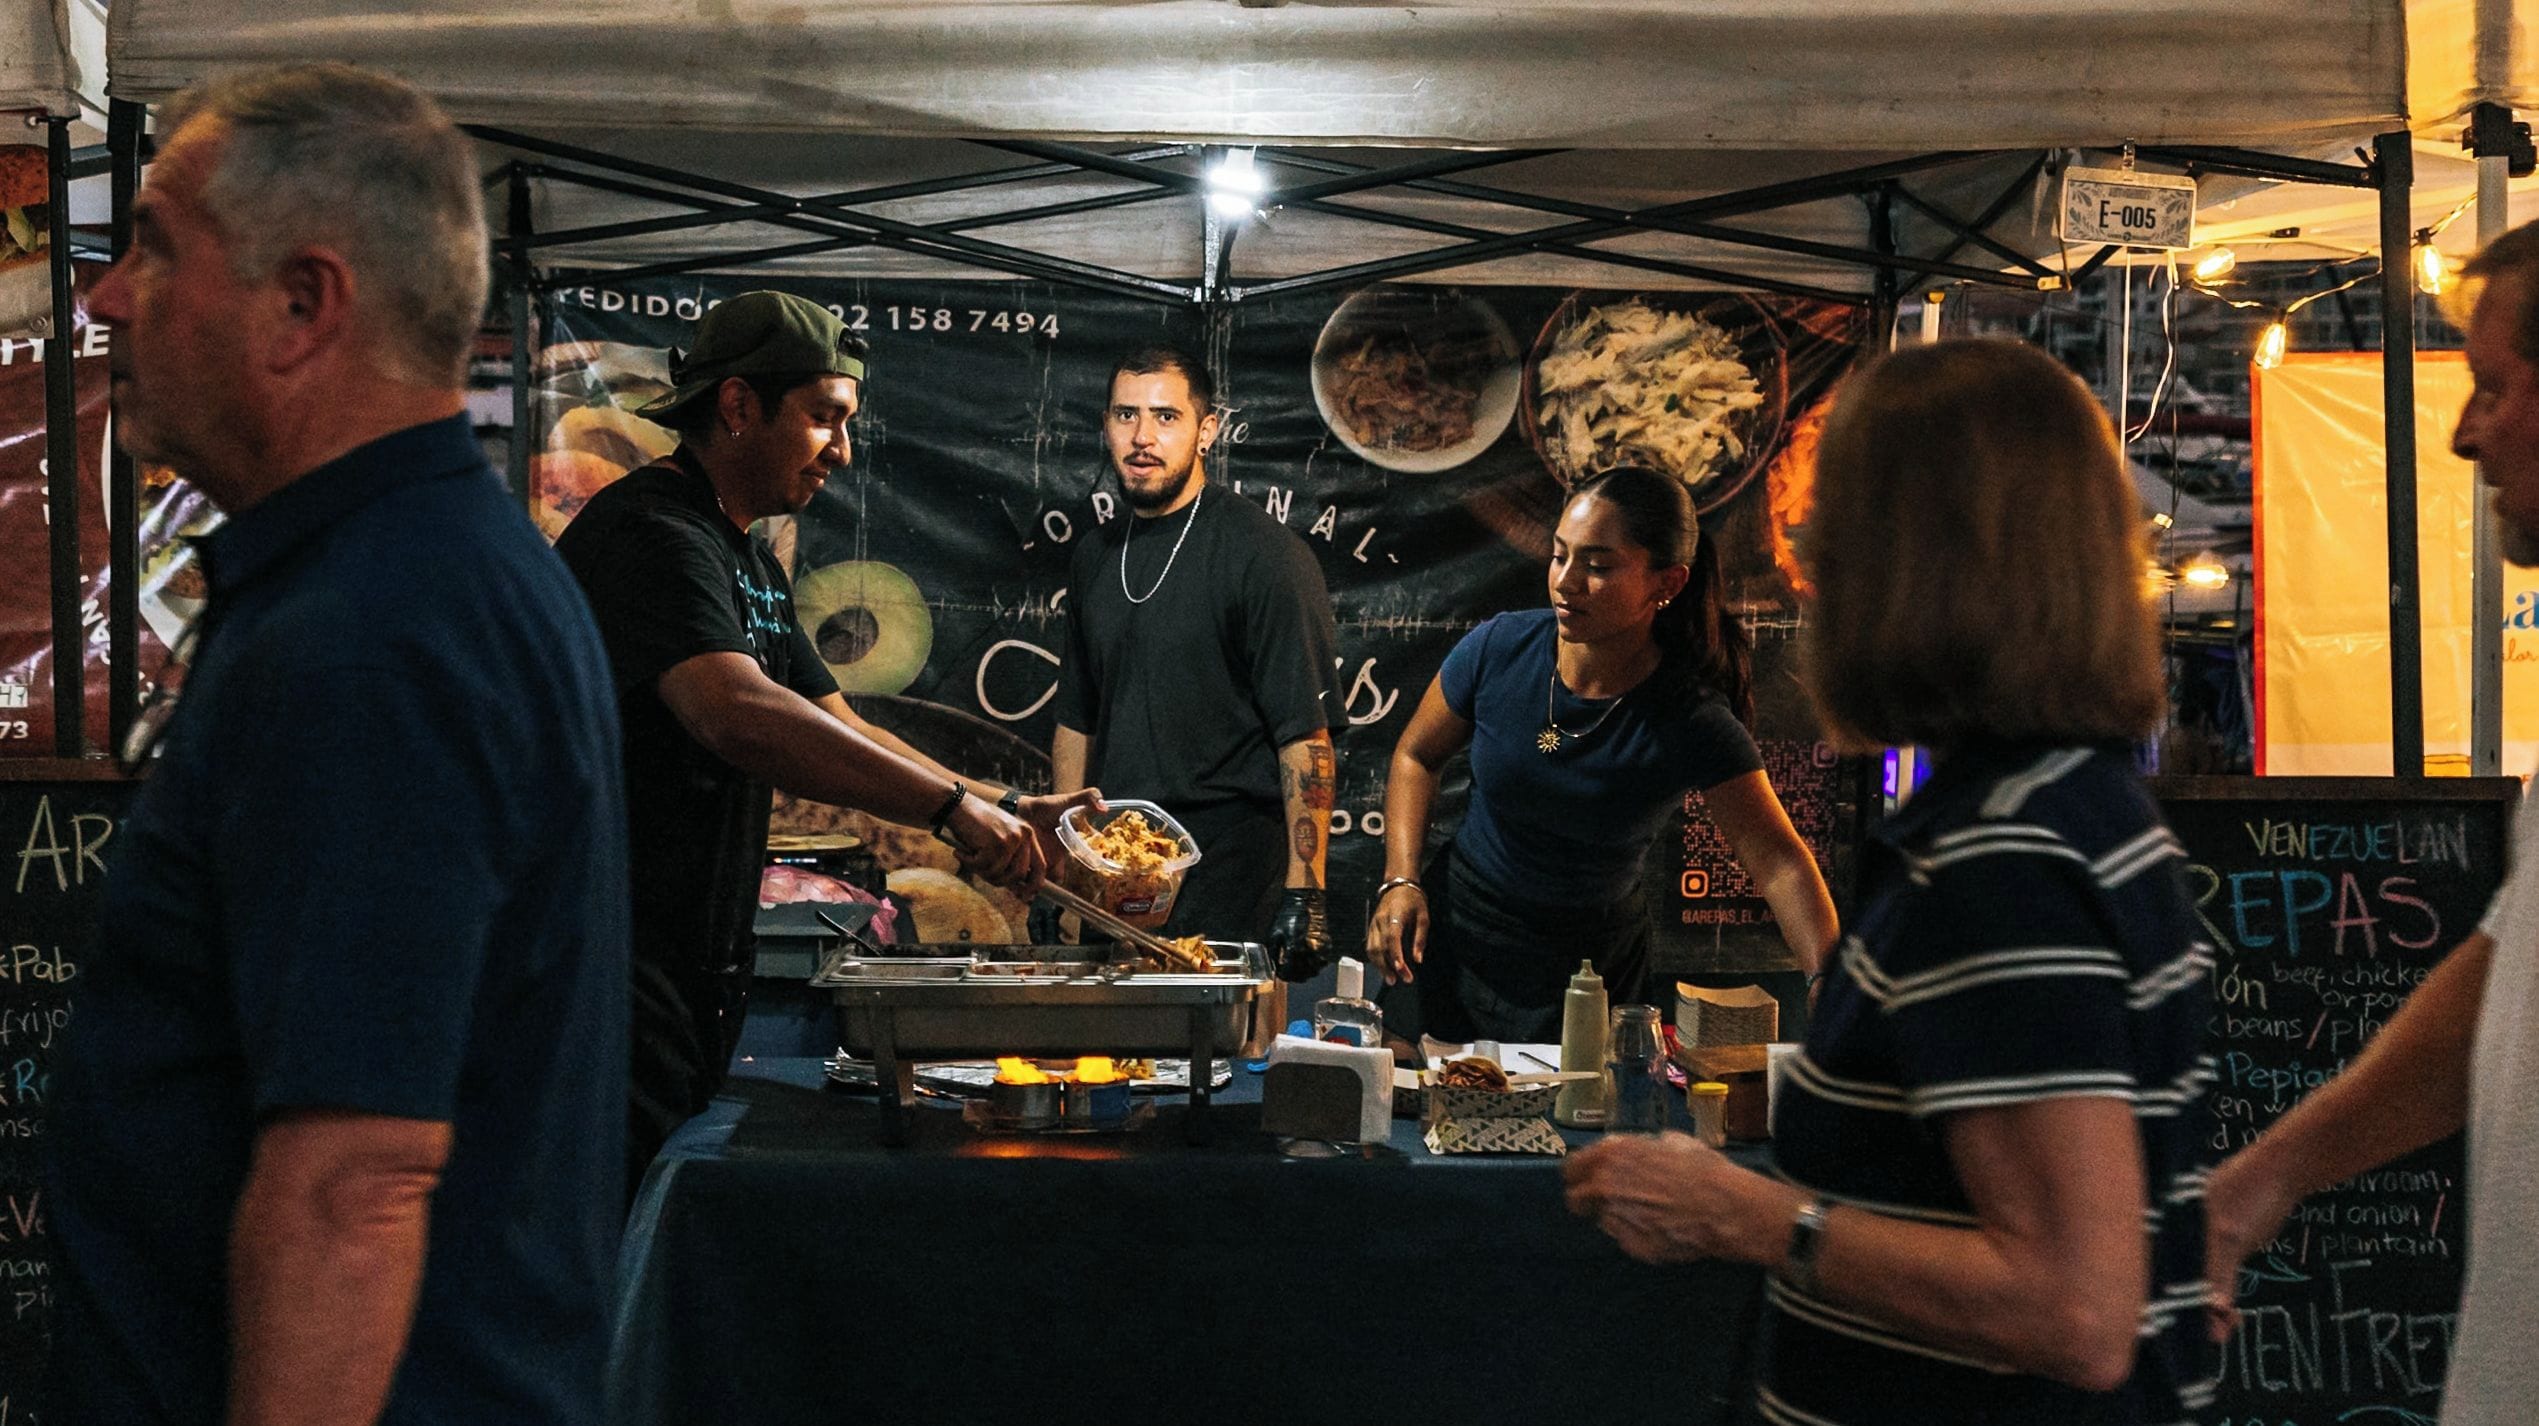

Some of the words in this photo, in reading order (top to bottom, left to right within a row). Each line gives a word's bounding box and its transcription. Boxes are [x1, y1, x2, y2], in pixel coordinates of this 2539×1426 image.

[2099, 199, 2157, 230] E-005
[886, 304, 954, 332] 158
[968, 309, 1062, 341] 7494
[1043, 479, 1379, 564] ORNAL
[2245, 817, 2471, 873] VENEZUELAN
